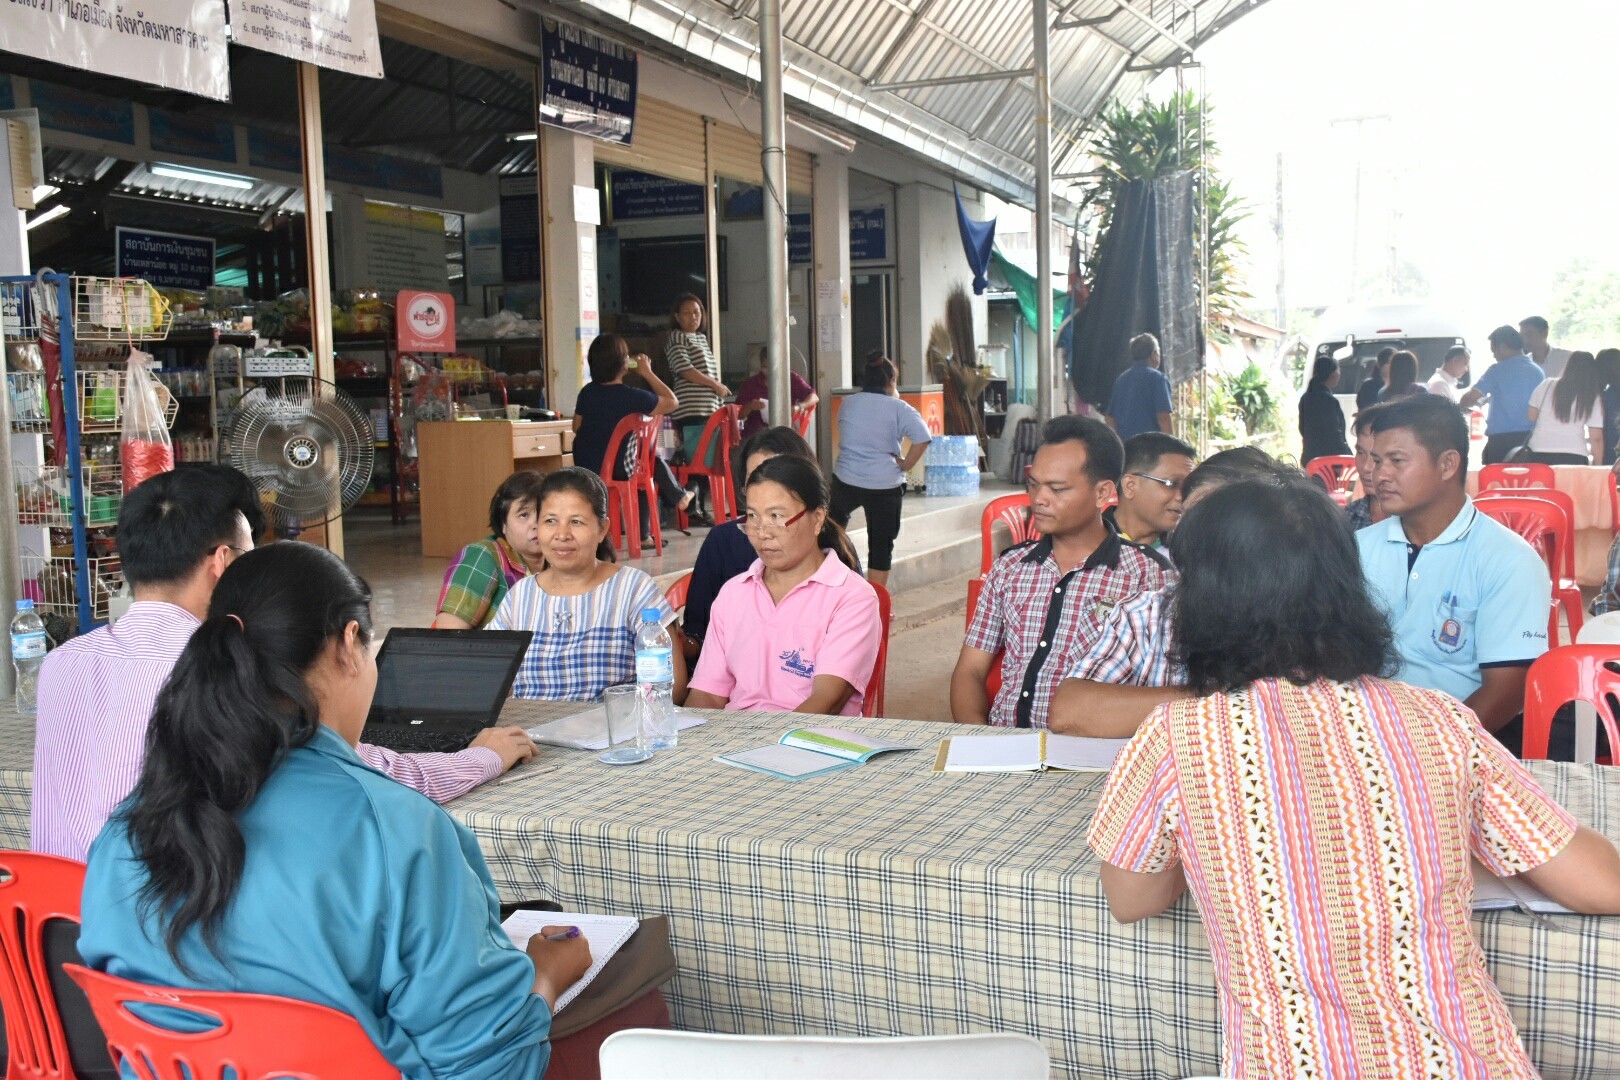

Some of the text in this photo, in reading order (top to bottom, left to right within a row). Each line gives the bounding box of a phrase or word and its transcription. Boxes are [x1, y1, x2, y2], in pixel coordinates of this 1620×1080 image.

[243, 22, 250, 32] 6.
[125, 237, 208, 260] สถาบันการเงินชุมชน
